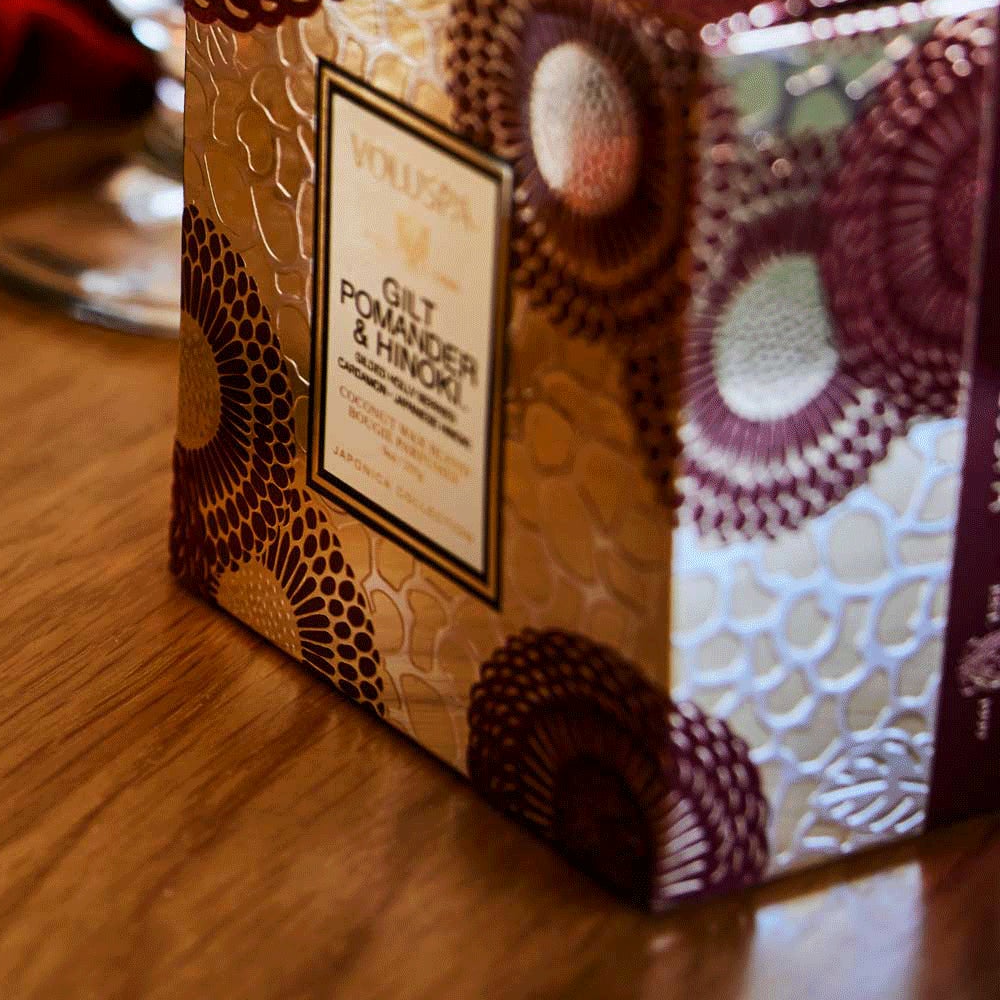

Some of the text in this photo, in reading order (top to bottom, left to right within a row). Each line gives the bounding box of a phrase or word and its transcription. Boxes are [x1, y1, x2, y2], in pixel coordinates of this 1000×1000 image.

[382, 276, 436, 327] GILT
[340, 278, 479, 388] POMANDER
[353, 317, 368, 348] &
